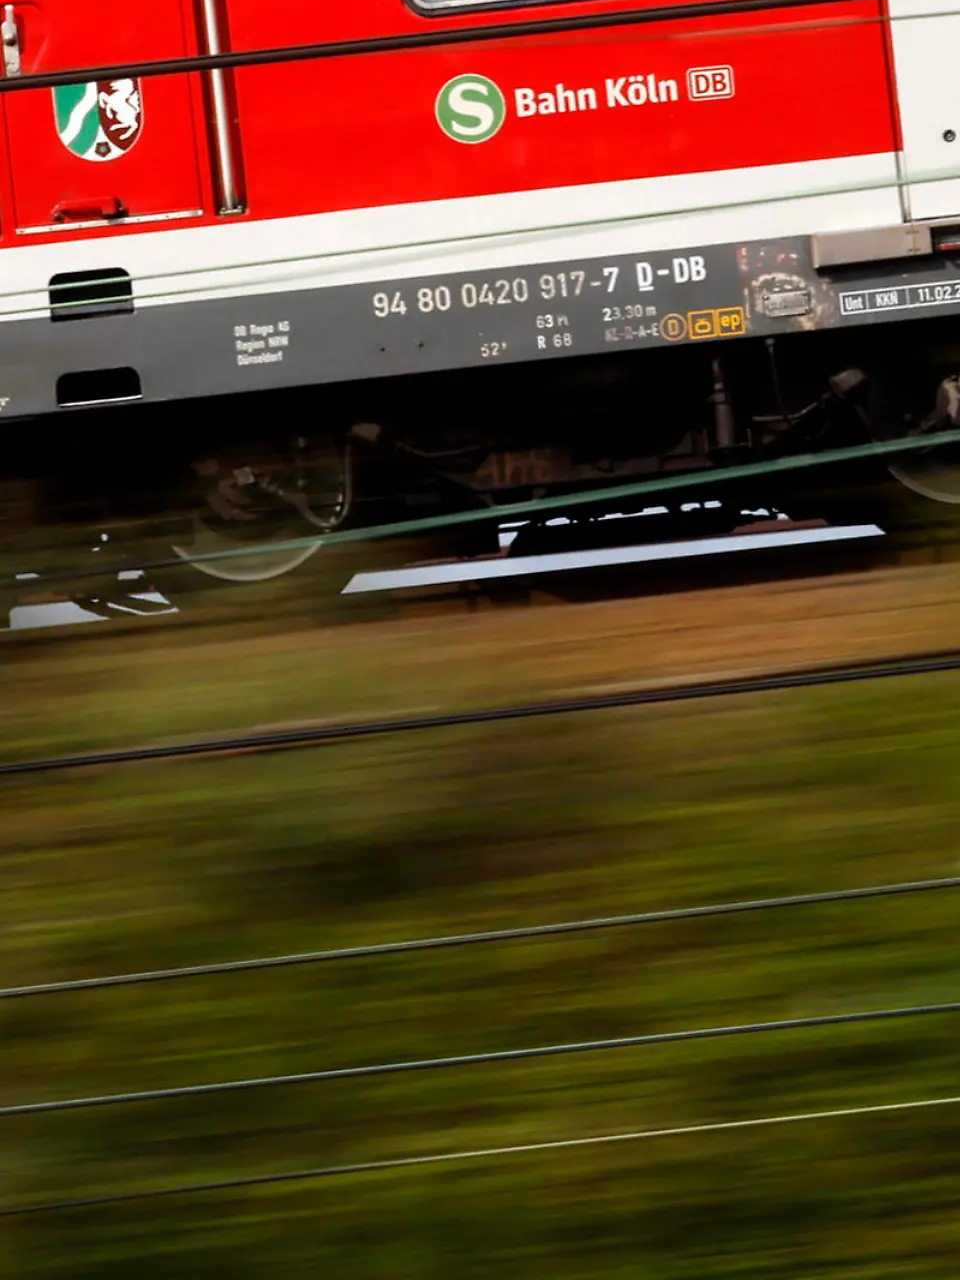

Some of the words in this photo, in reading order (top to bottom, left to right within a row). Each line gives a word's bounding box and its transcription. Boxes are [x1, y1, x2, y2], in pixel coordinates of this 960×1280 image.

[444, 78, 498, 139] S
[514, 83, 597, 118] Bahn
[605, 74, 679, 108] Köln
[692, 70, 730, 97] DB
[373, 291, 408, 318] 94
[417, 286, 451, 313] 80
[461, 277, 529, 308] 0420
[539, 266, 620, 300] 917-7
[635, 255, 707, 292] D-DB
[536, 313, 555, 329] 63
[721, 311, 740, 331] ep
[536, 335, 547, 350] R
